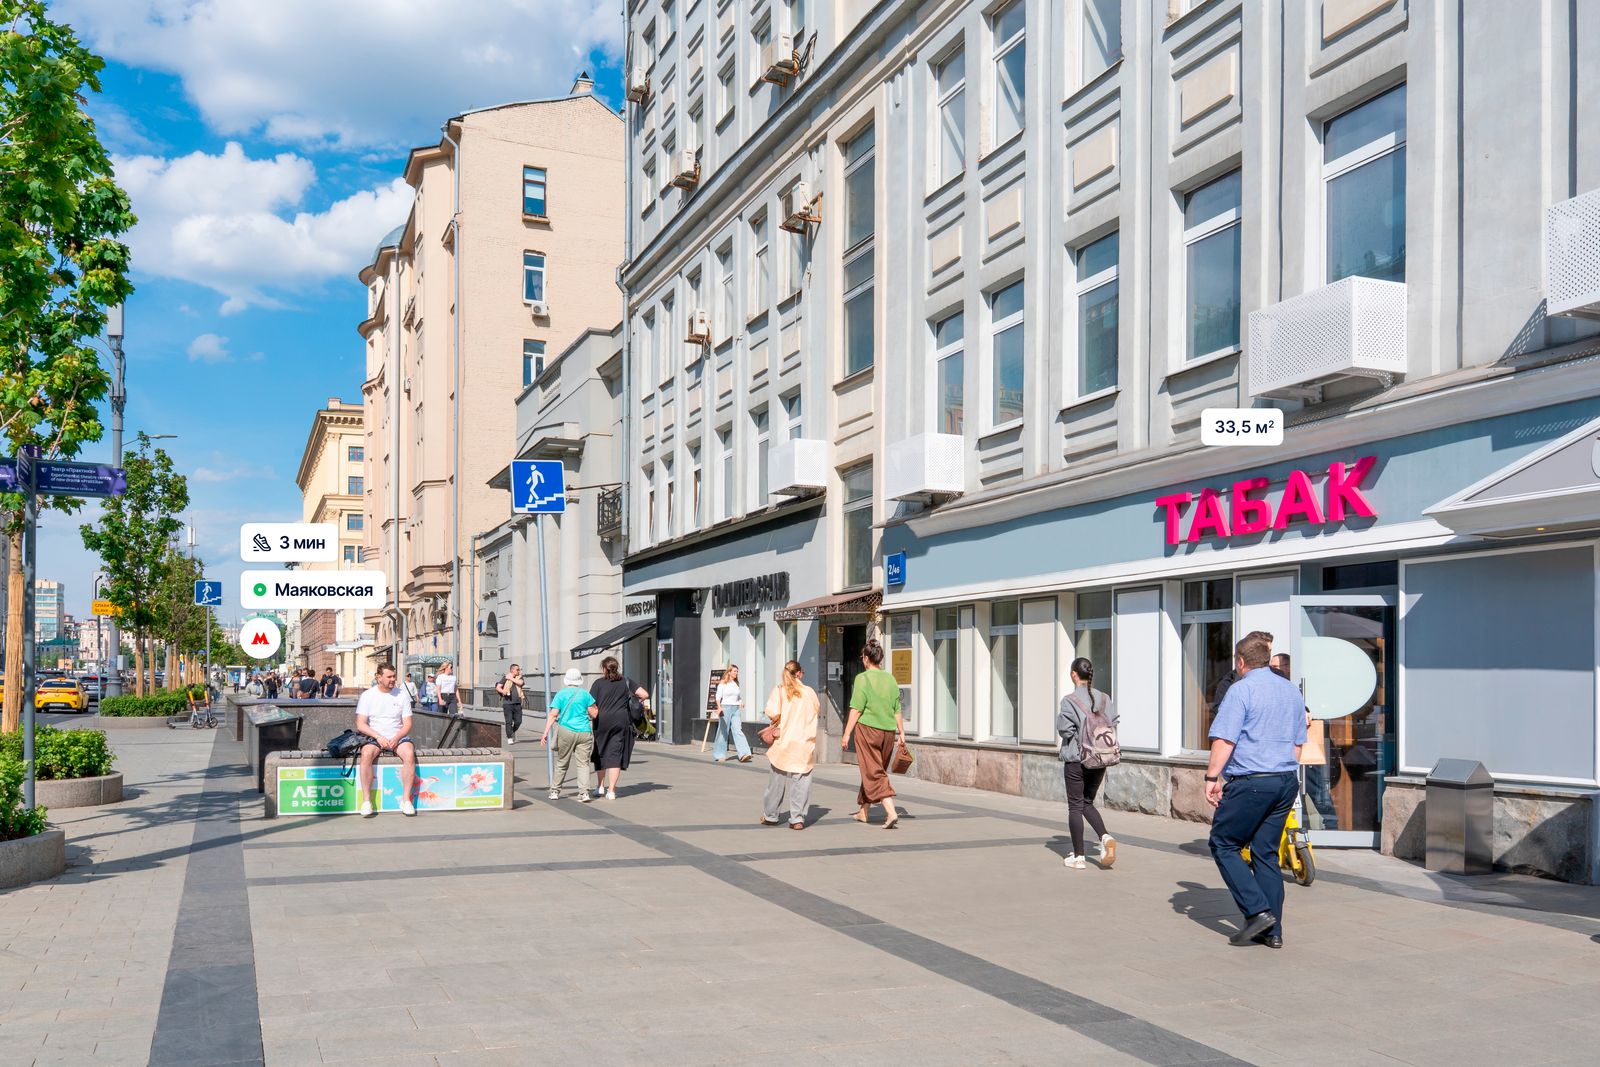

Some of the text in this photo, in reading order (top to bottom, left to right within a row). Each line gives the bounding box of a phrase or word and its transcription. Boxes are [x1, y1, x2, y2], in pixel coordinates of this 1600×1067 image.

[1155, 456, 1379, 545] ТАБАК
[292, 784, 345, 798] ЛЕТО
[292, 799, 344, 808] В МОСКВЕ
